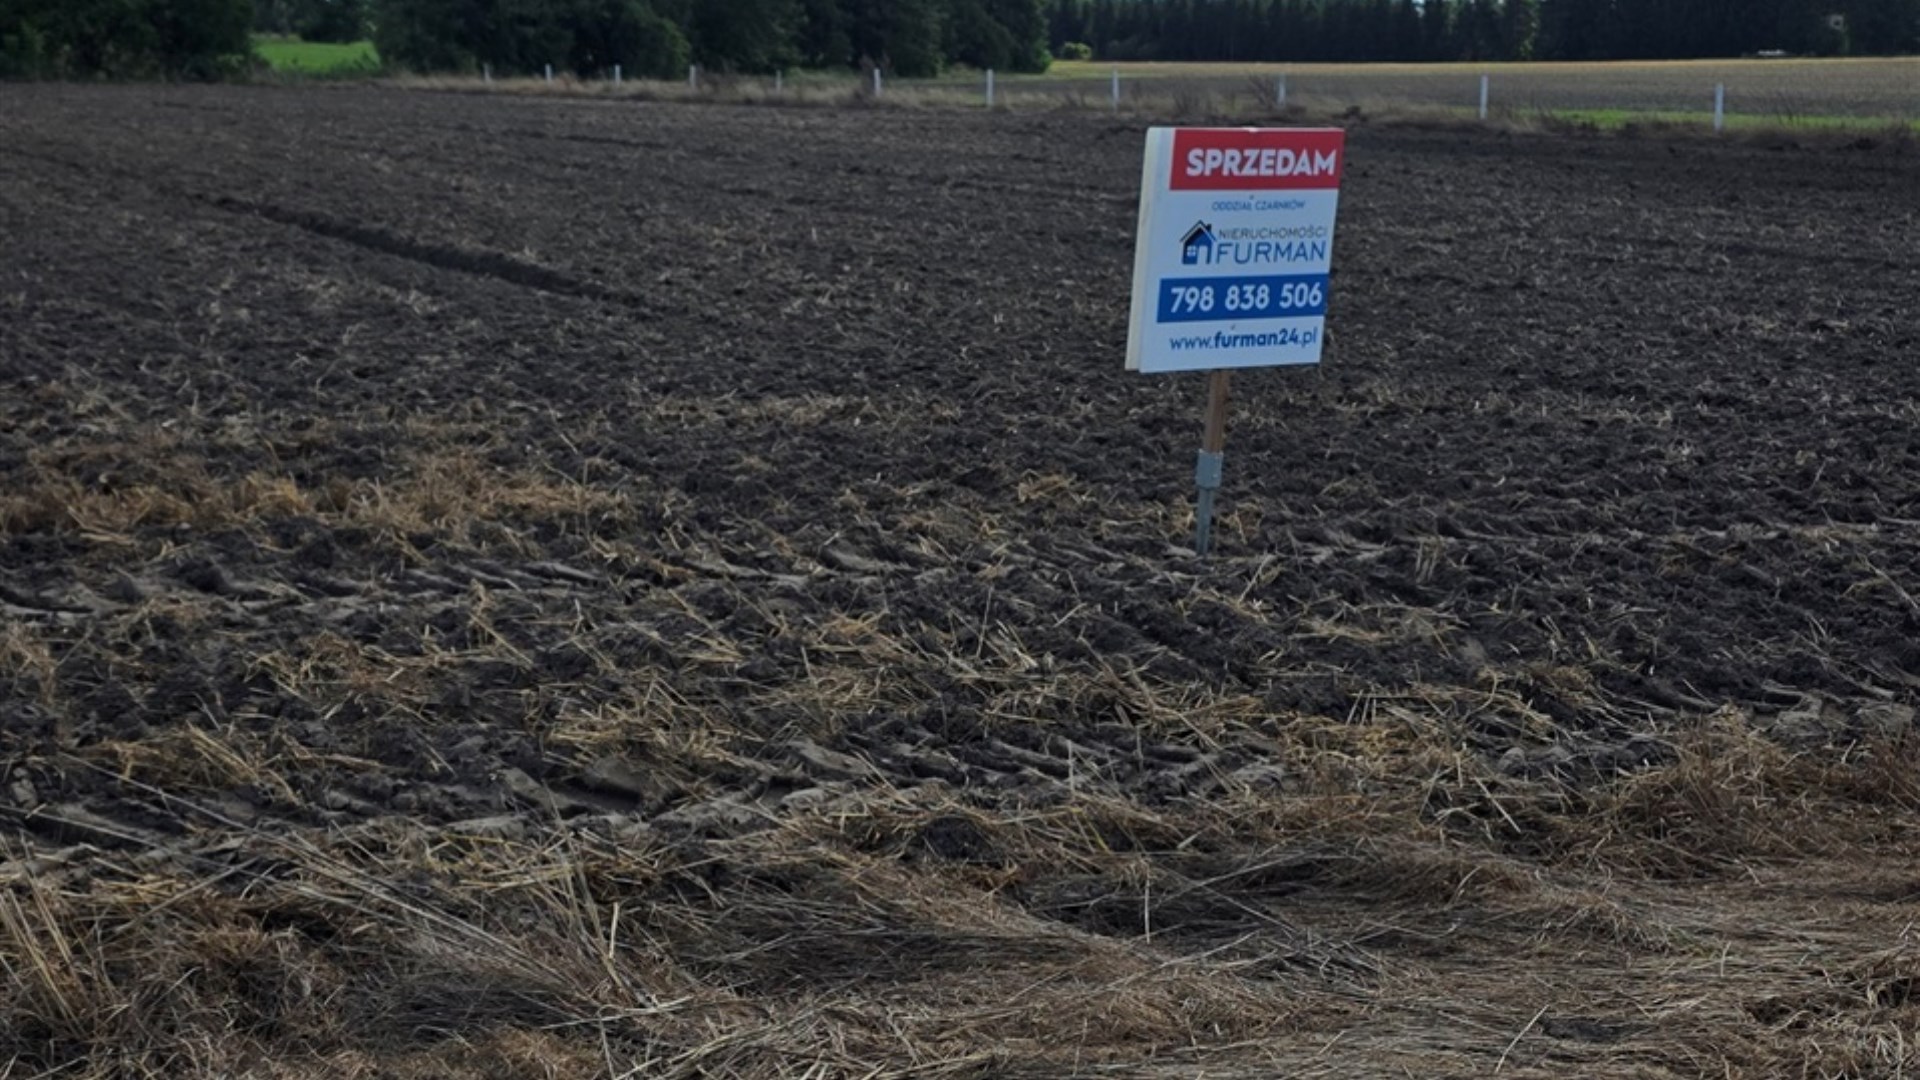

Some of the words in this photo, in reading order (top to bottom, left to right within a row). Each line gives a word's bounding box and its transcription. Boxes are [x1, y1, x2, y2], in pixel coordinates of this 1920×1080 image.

[1186, 148, 1336, 176] SPRZEDAM
[1211, 201, 1252, 212] ODDZIAŁ
[1218, 225, 1327, 240] NIERUCHOMOŚCI
[1216, 241, 1326, 264] FURMAN
[1171, 286, 1214, 313] 798
[1225, 284, 1270, 310] 838
[1279, 282, 1322, 308] 506
[1169, 327, 1317, 349] www.furman24.pl
